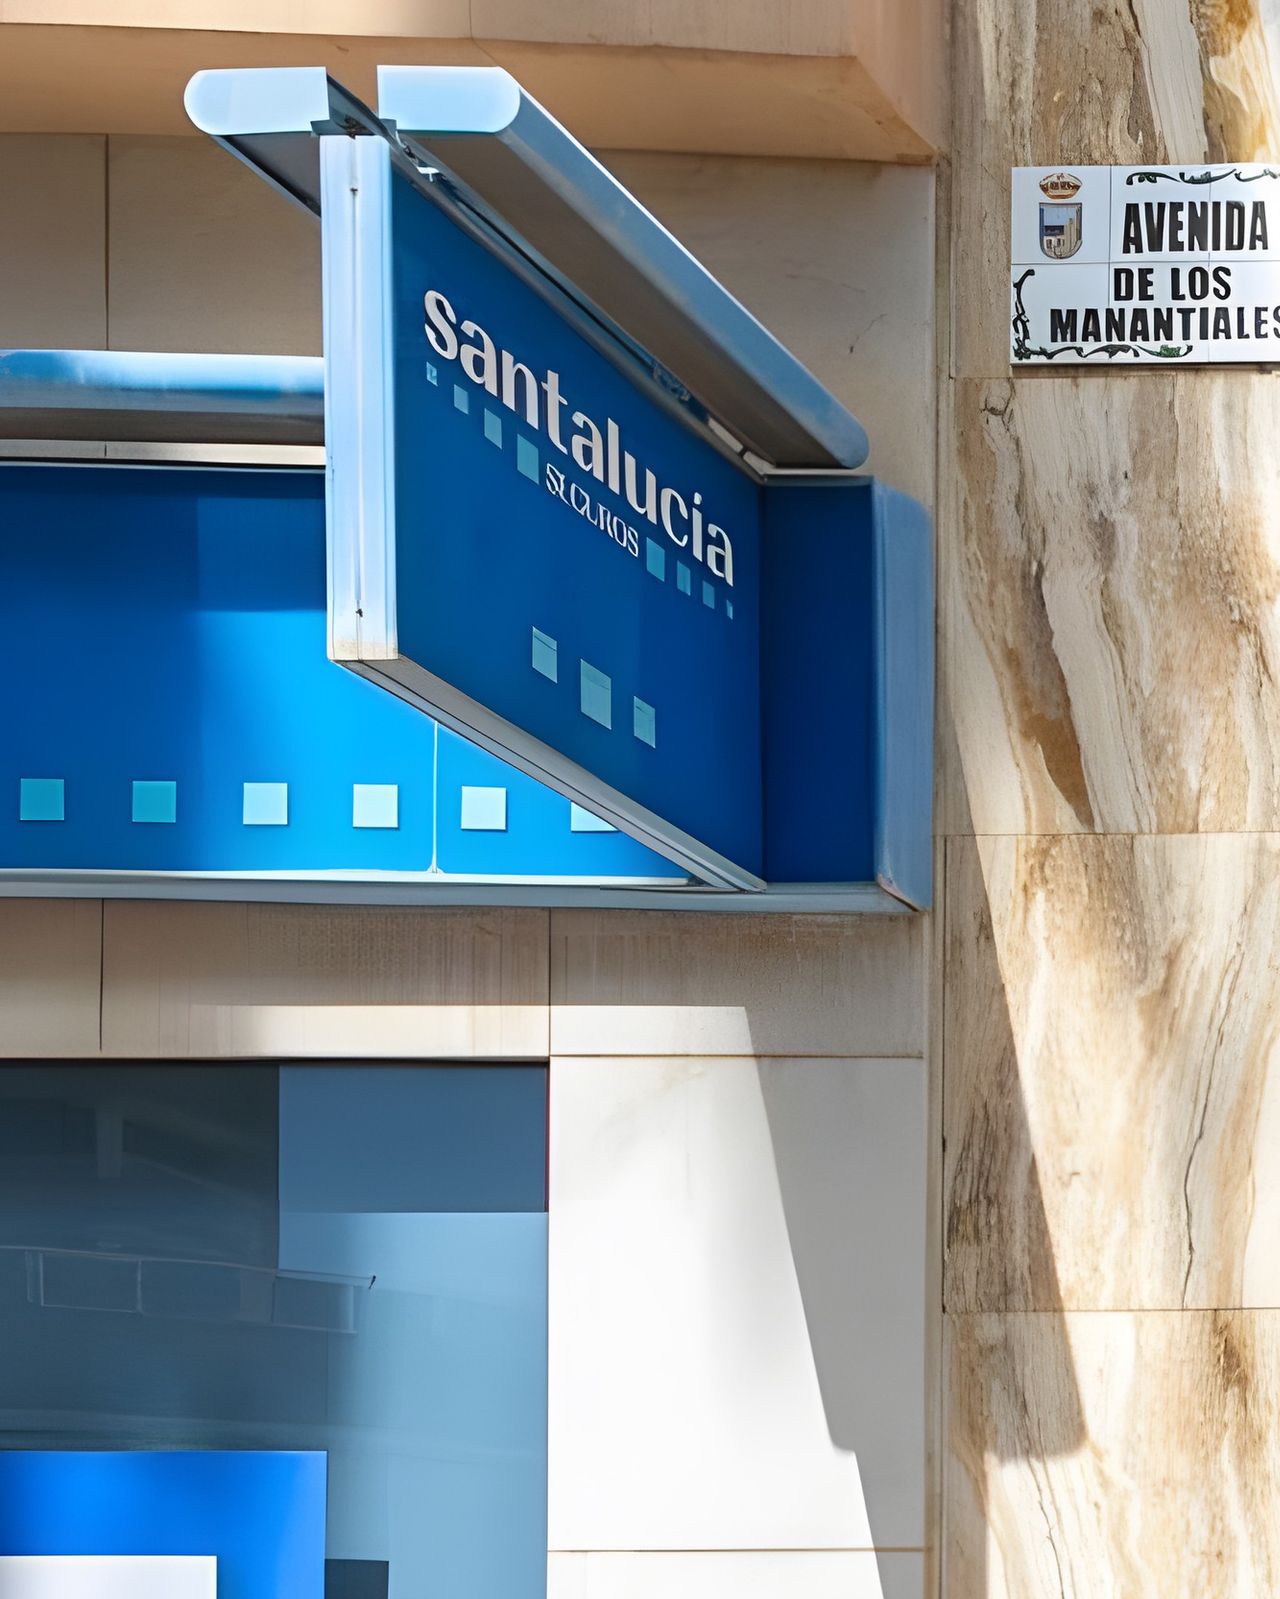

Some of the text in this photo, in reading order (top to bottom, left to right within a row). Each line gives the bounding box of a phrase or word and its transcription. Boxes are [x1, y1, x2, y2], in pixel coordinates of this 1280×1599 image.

[1123, 201, 1268, 254] AVENIDA
[1114, 266, 1231, 301] DE LOS
